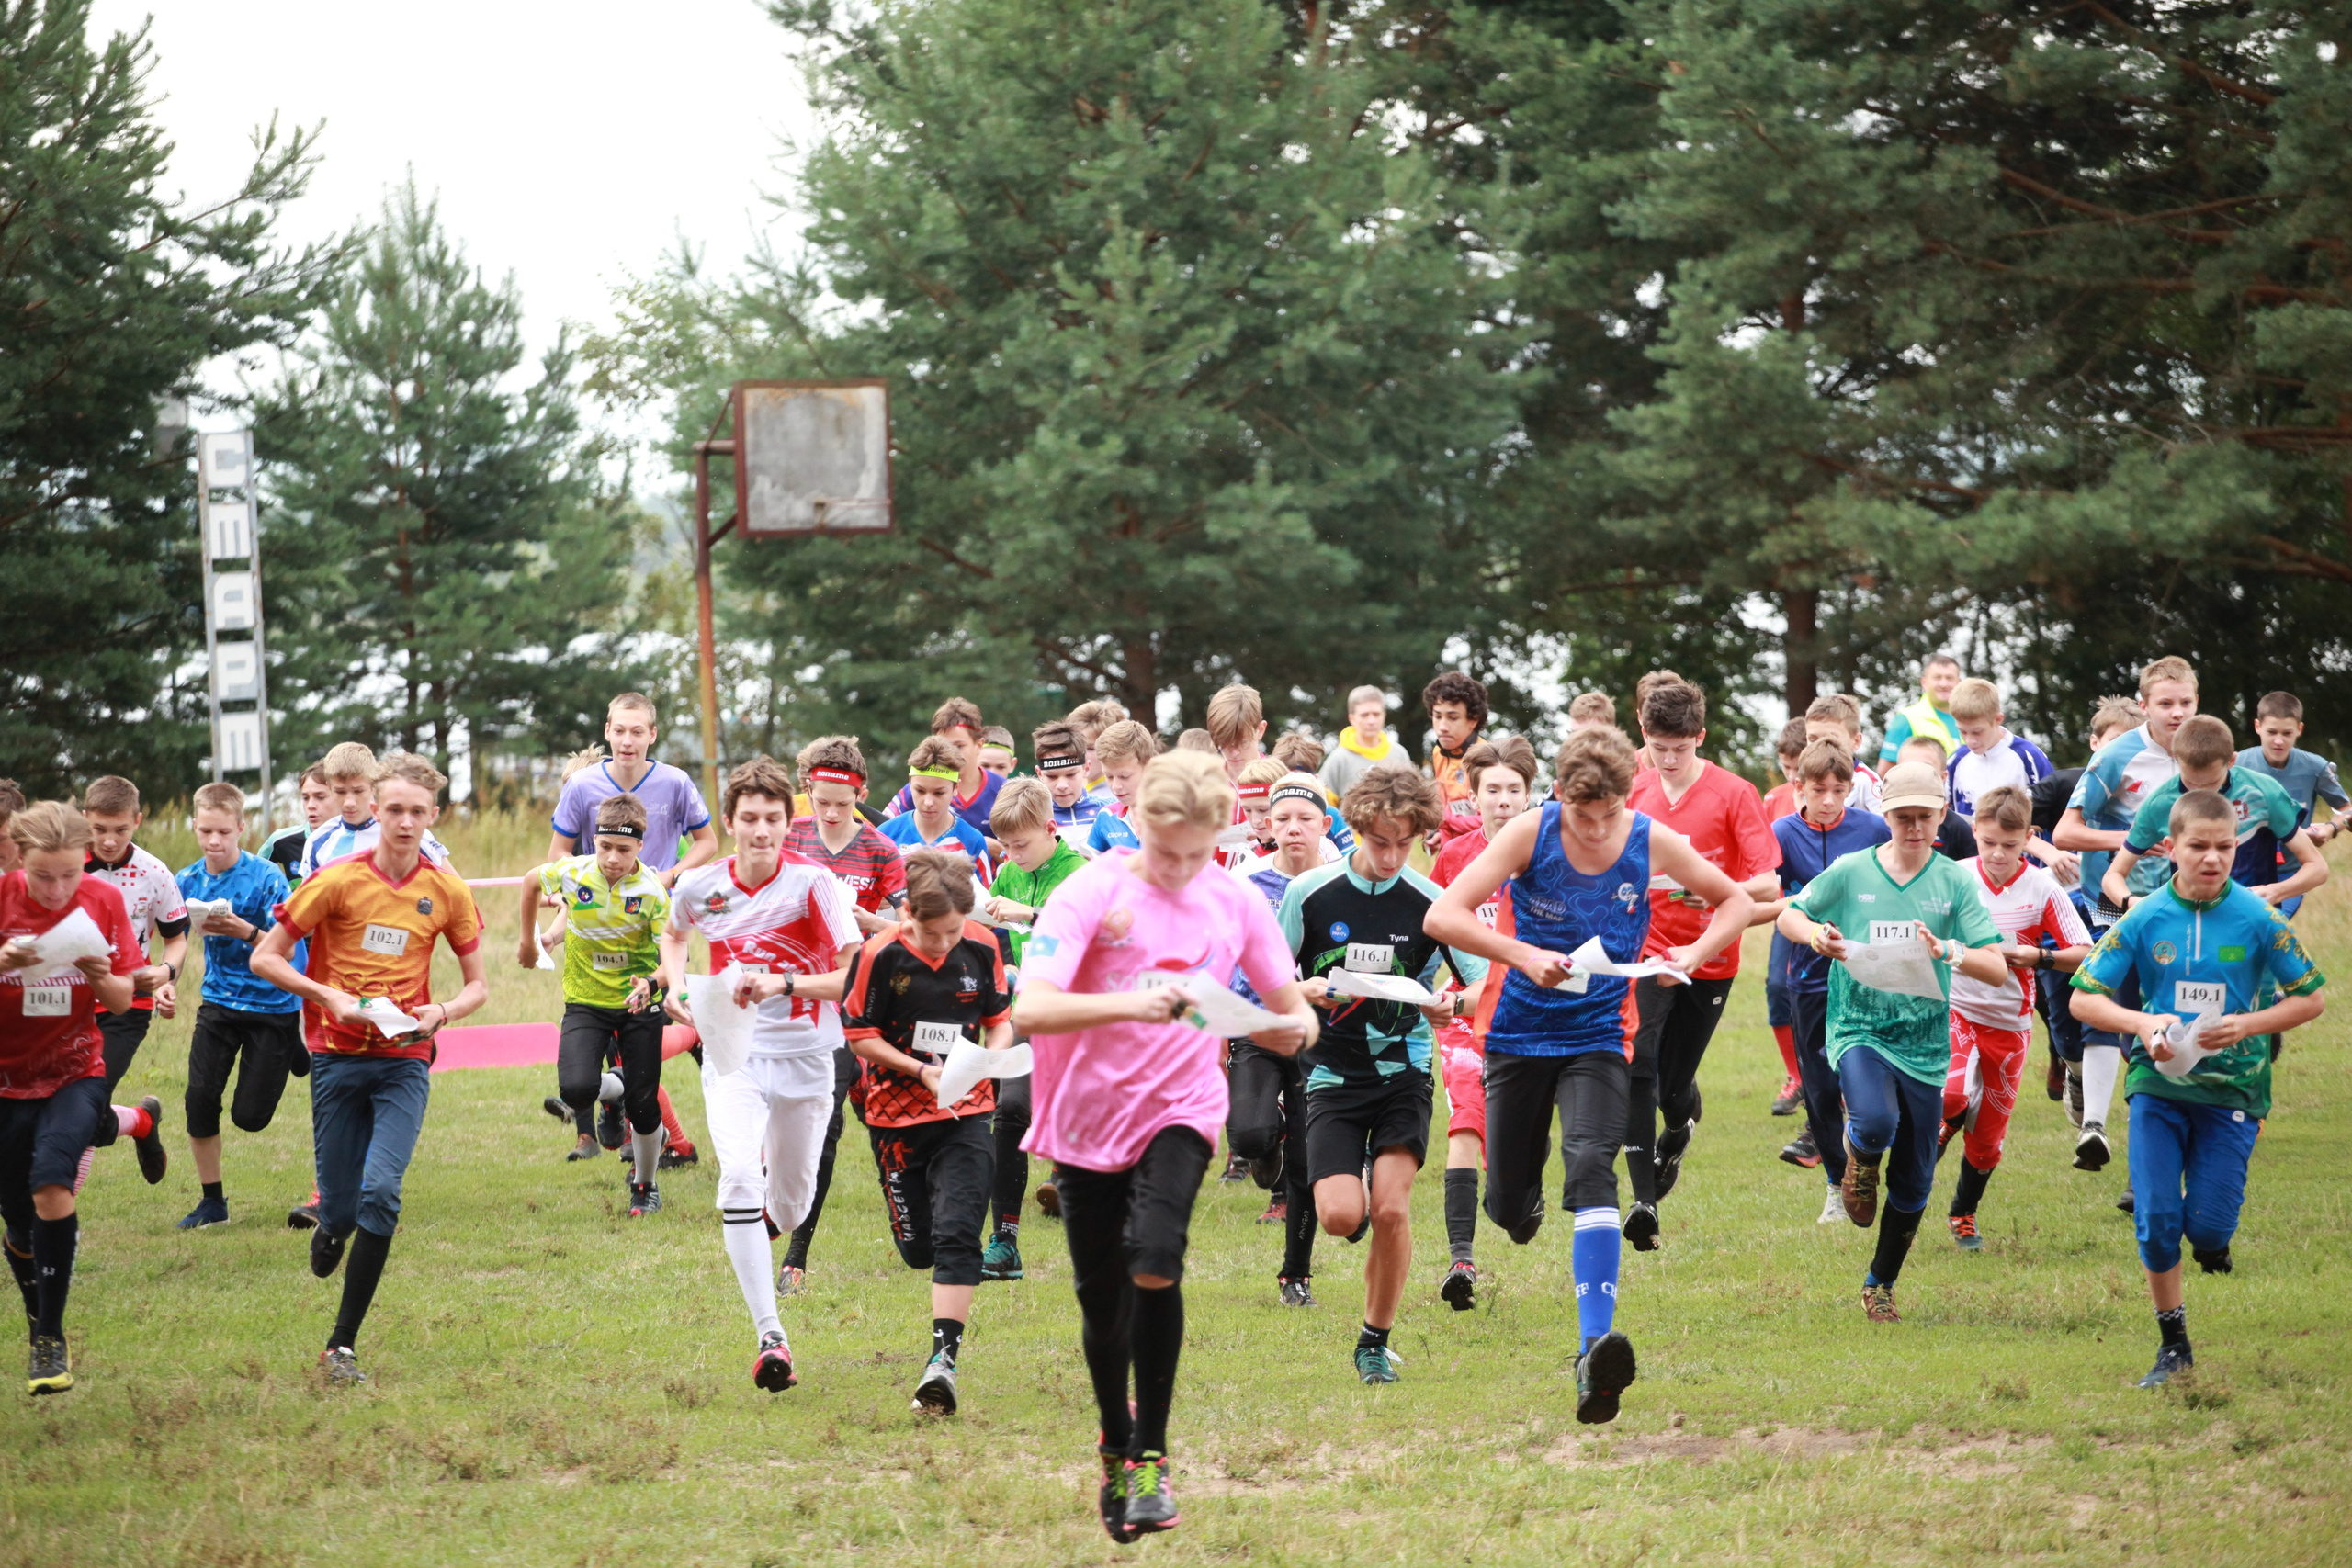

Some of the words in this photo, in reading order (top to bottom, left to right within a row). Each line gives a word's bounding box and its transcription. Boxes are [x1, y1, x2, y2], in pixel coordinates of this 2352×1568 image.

[816, 770, 850, 781] noname
[1272, 787, 1314, 802] noname
[369, 930, 403, 946] 102.1
[1389, 934, 1409, 942] Тула
[1876, 926, 1910, 939] 117.1
[596, 953, 625, 964] 104.1
[742, 940, 777, 963] Run
[1352, 948, 1388, 963] 116.1
[29, 992, 67, 1005] 101.1
[2181, 987, 2221, 1002] 149.1
[921, 1027, 957, 1043] 108.1
